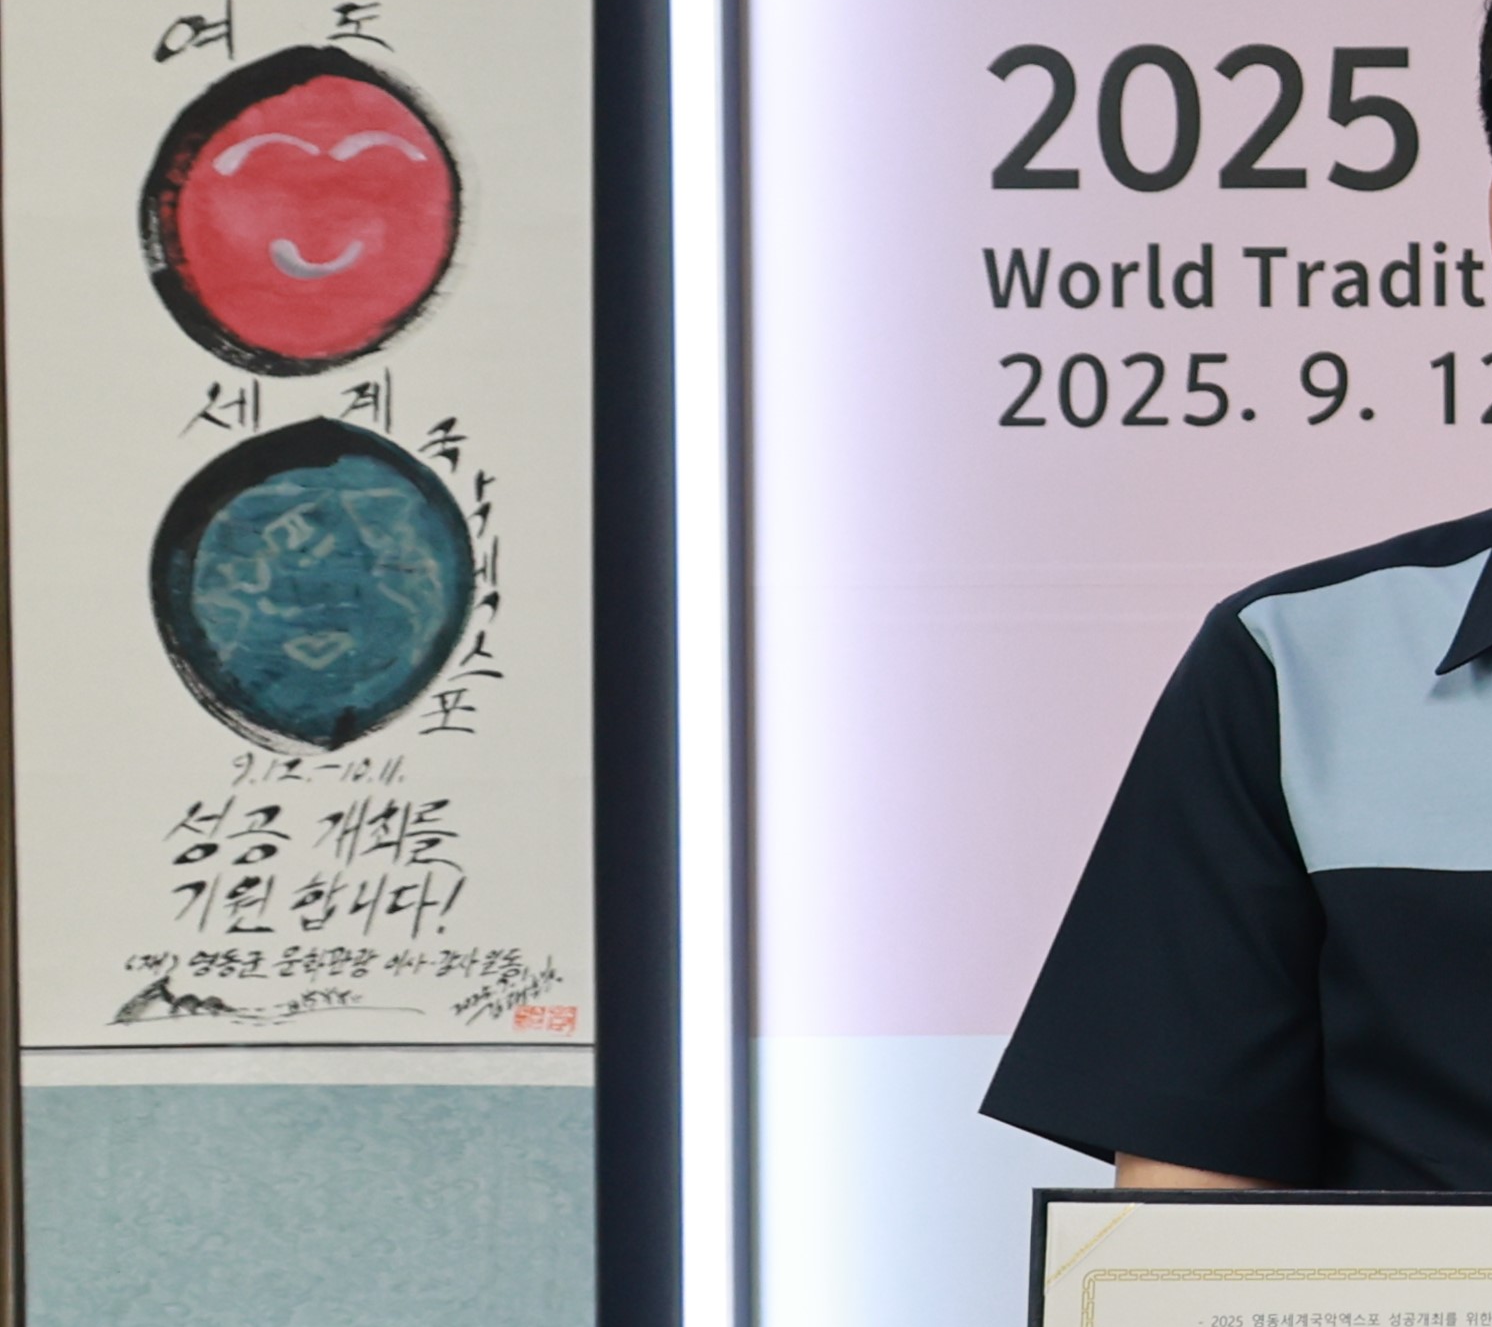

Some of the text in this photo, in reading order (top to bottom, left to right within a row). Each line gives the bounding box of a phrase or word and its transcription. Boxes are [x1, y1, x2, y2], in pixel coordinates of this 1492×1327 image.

[988, 44, 1419, 192] 2025
[983, 243, 1213, 309] World
[999, 353, 1255, 428] 2025.
[1301, 352, 1374, 425] 9.
[164, 795, 465, 873] 성공 개최를
[188, 948, 268, 976] 영동군
[1211, 1315, 1243, 1327] 2025
[1389, 1312, 1457, 1327] 성공개최를
[1467, 1312, 1492, 1326] 위한
